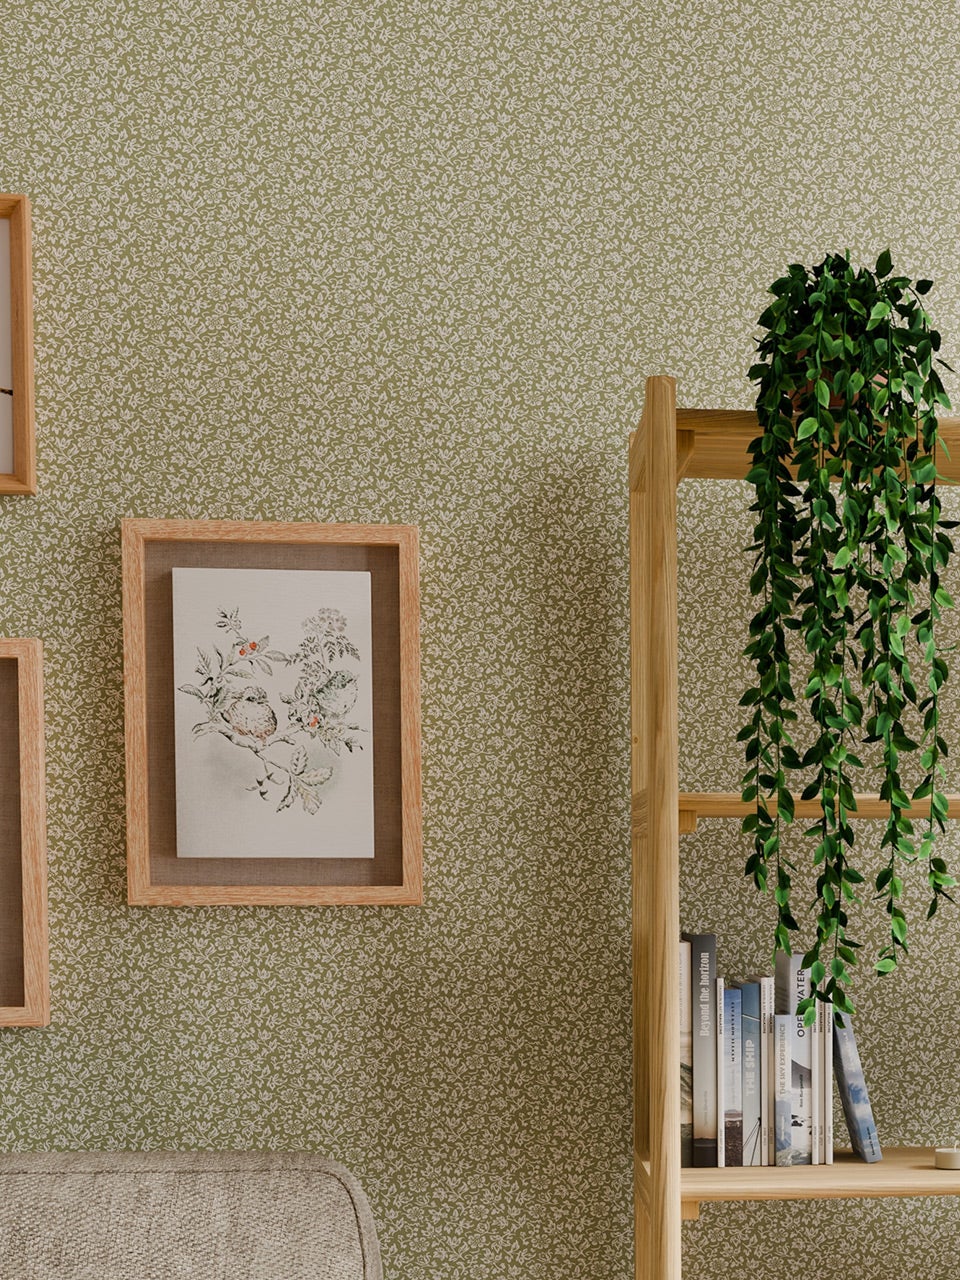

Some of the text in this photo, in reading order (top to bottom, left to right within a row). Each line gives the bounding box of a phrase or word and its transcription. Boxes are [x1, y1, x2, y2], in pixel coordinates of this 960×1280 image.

[699, 952, 711, 1037] Beyond the horizon
[796, 1015, 805, 1038] OPE
[745, 1039, 755, 1097] THE SHIP
